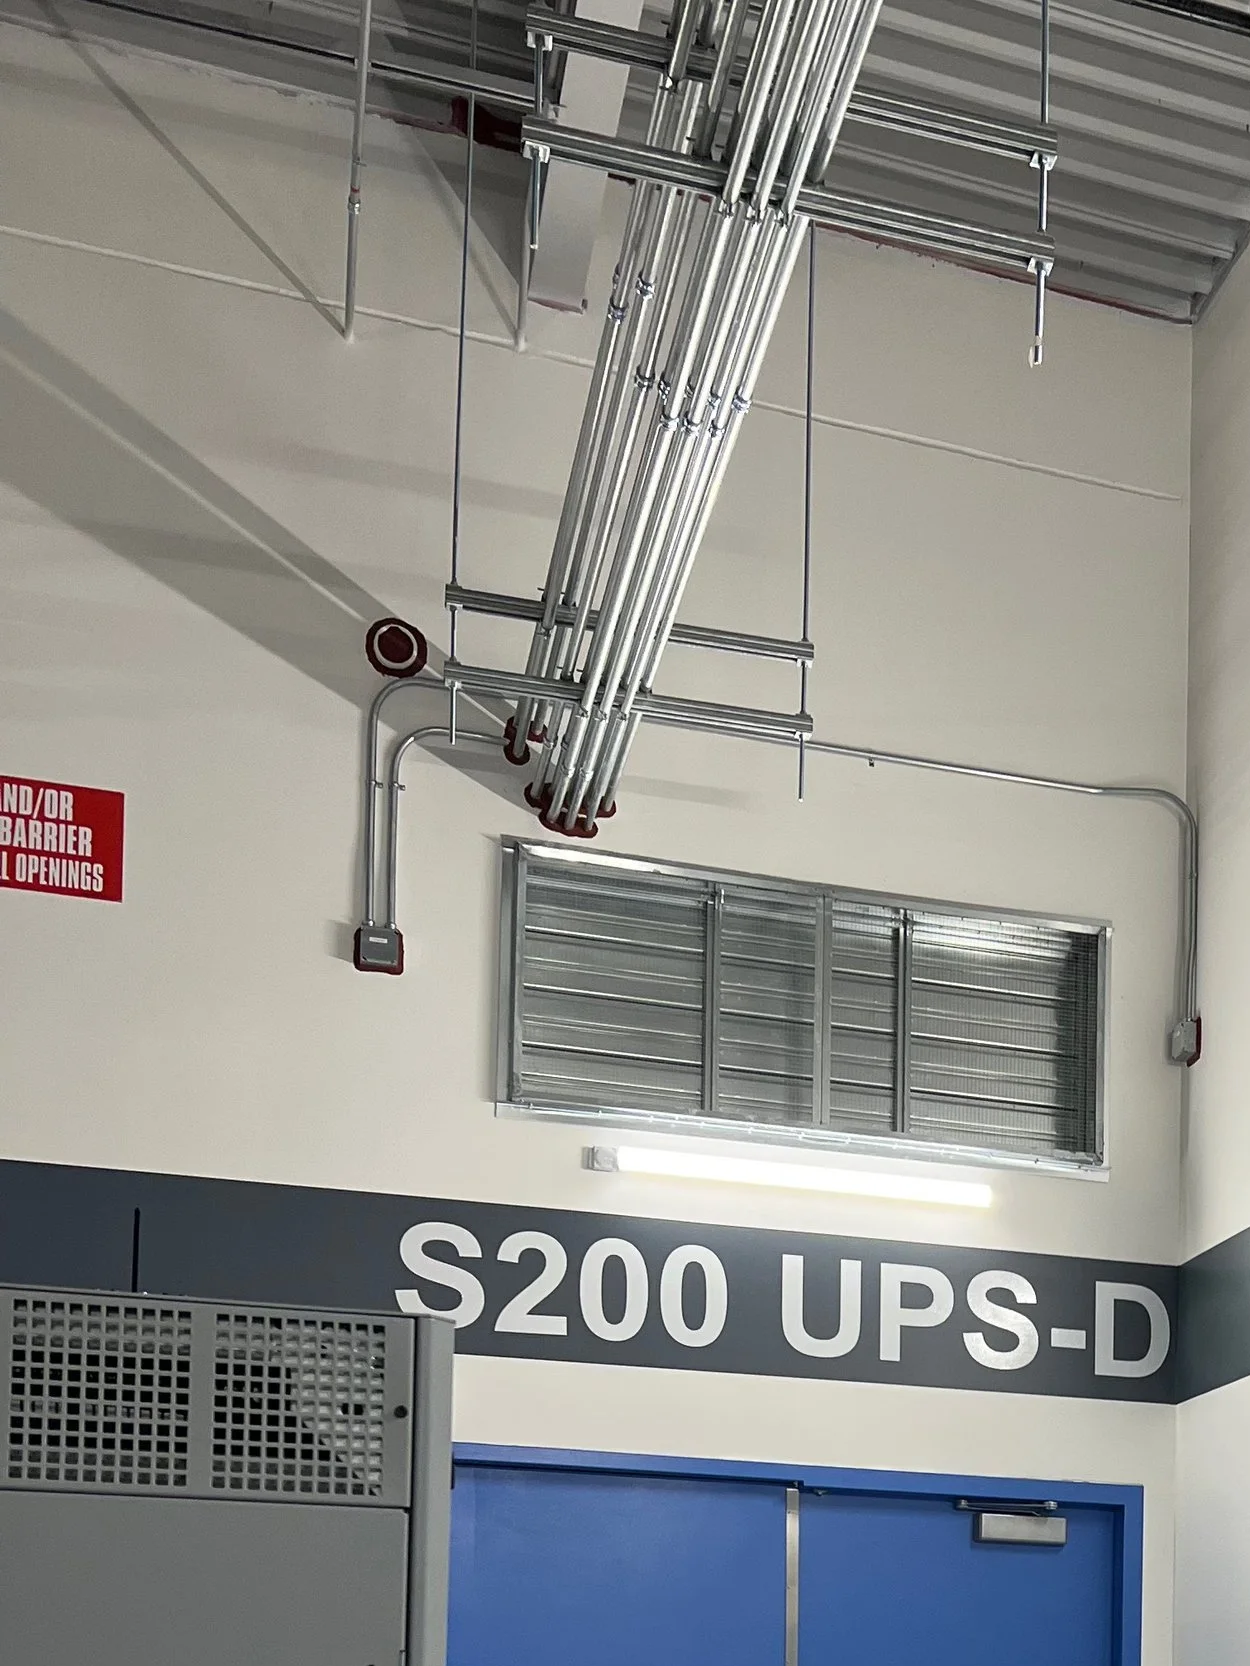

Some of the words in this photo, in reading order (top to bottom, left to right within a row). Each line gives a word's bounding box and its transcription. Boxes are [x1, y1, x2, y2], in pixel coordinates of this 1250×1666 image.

[0, 782, 74, 822] ND/OR
[0, 815, 93, 857] BARRIER
[15, 852, 104, 893] OPENINGS
[394, 1221, 729, 1348] S200
[779, 1253, 1172, 1379] UPS-D
